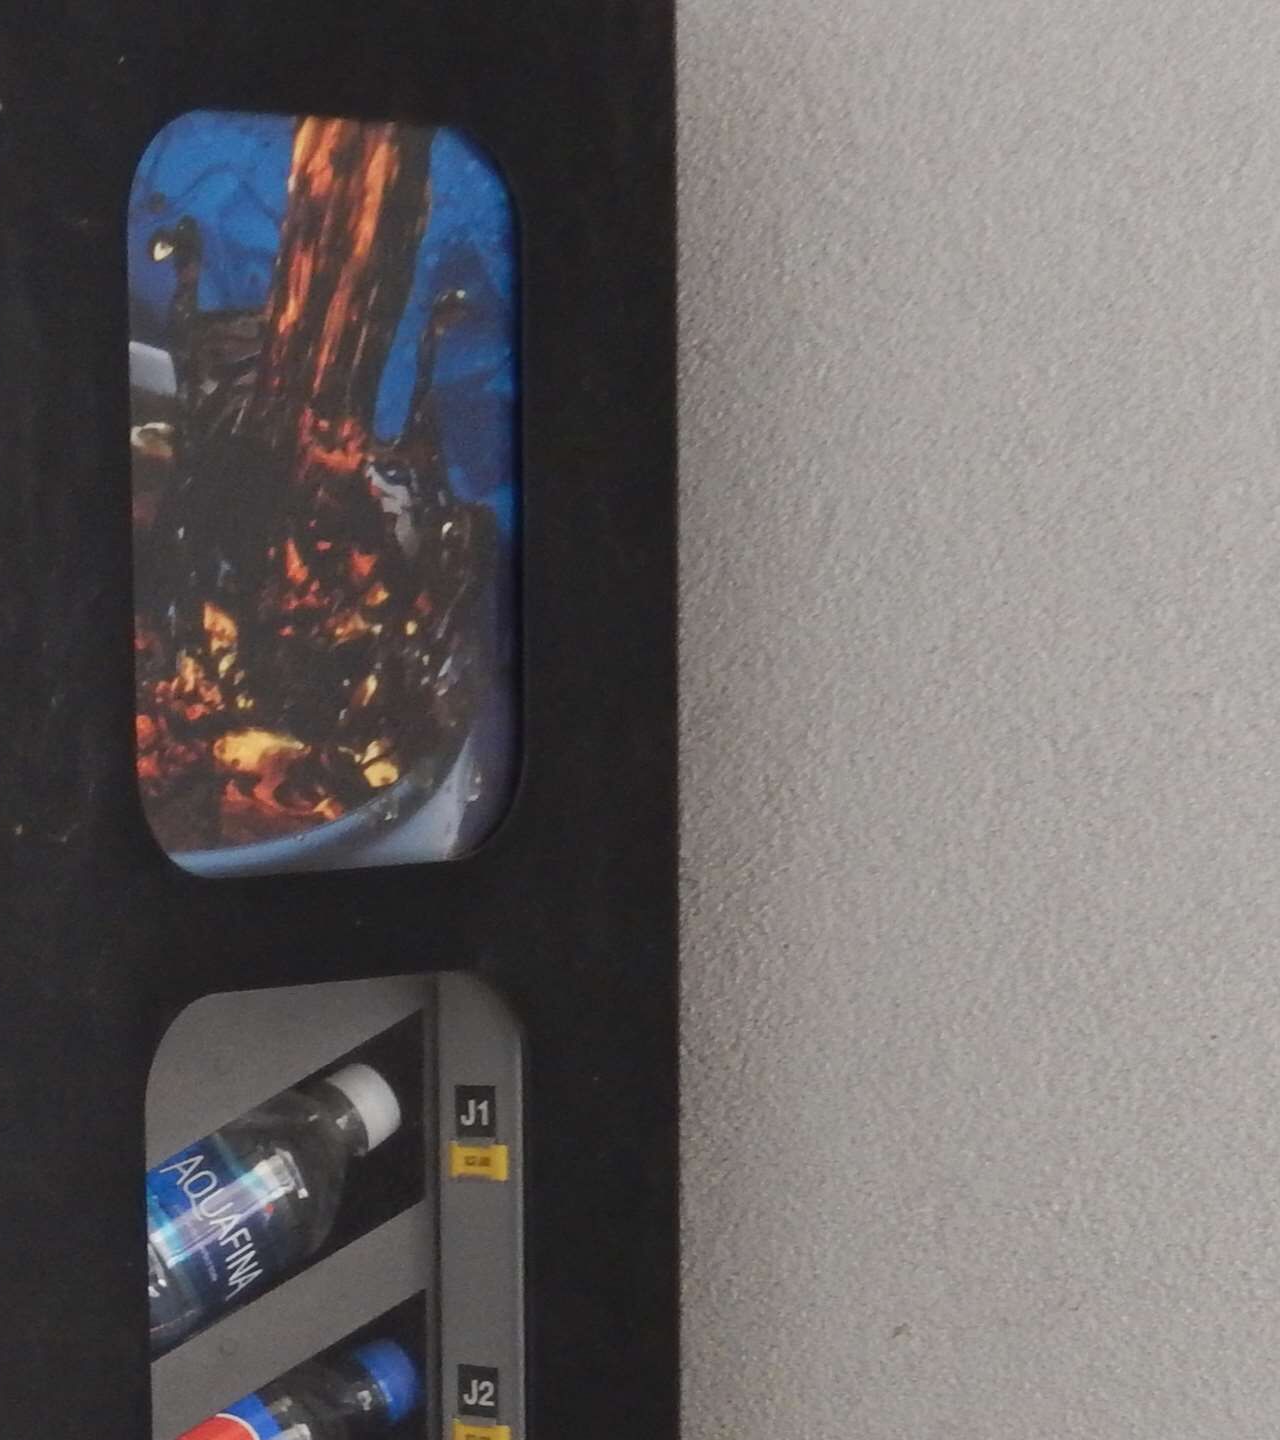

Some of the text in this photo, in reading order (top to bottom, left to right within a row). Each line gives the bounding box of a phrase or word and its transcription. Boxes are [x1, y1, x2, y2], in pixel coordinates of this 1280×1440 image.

[460, 1099, 491, 1127] J1
[159, 1152, 264, 1302] AQUAFINA
[464, 1379, 496, 1407] J2
